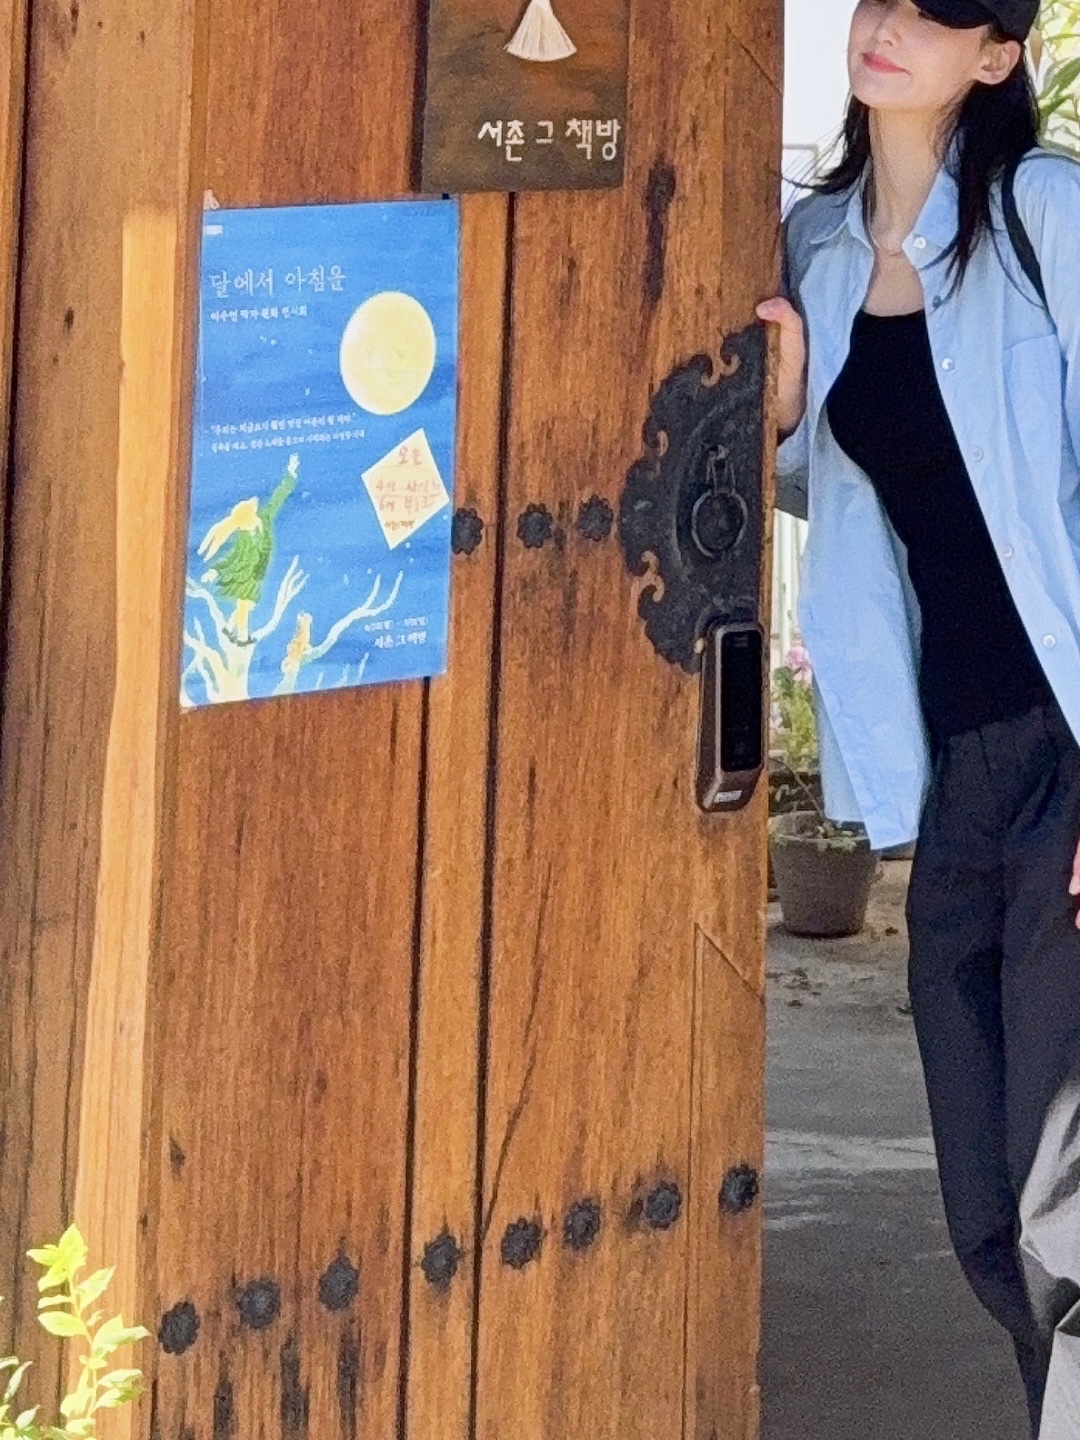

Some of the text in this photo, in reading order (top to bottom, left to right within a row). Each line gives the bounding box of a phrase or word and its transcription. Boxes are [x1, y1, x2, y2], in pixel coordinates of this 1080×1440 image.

[477, 118, 622, 162] 서촌 그 책방
[208, 264, 347, 298] 달에서 아침을
